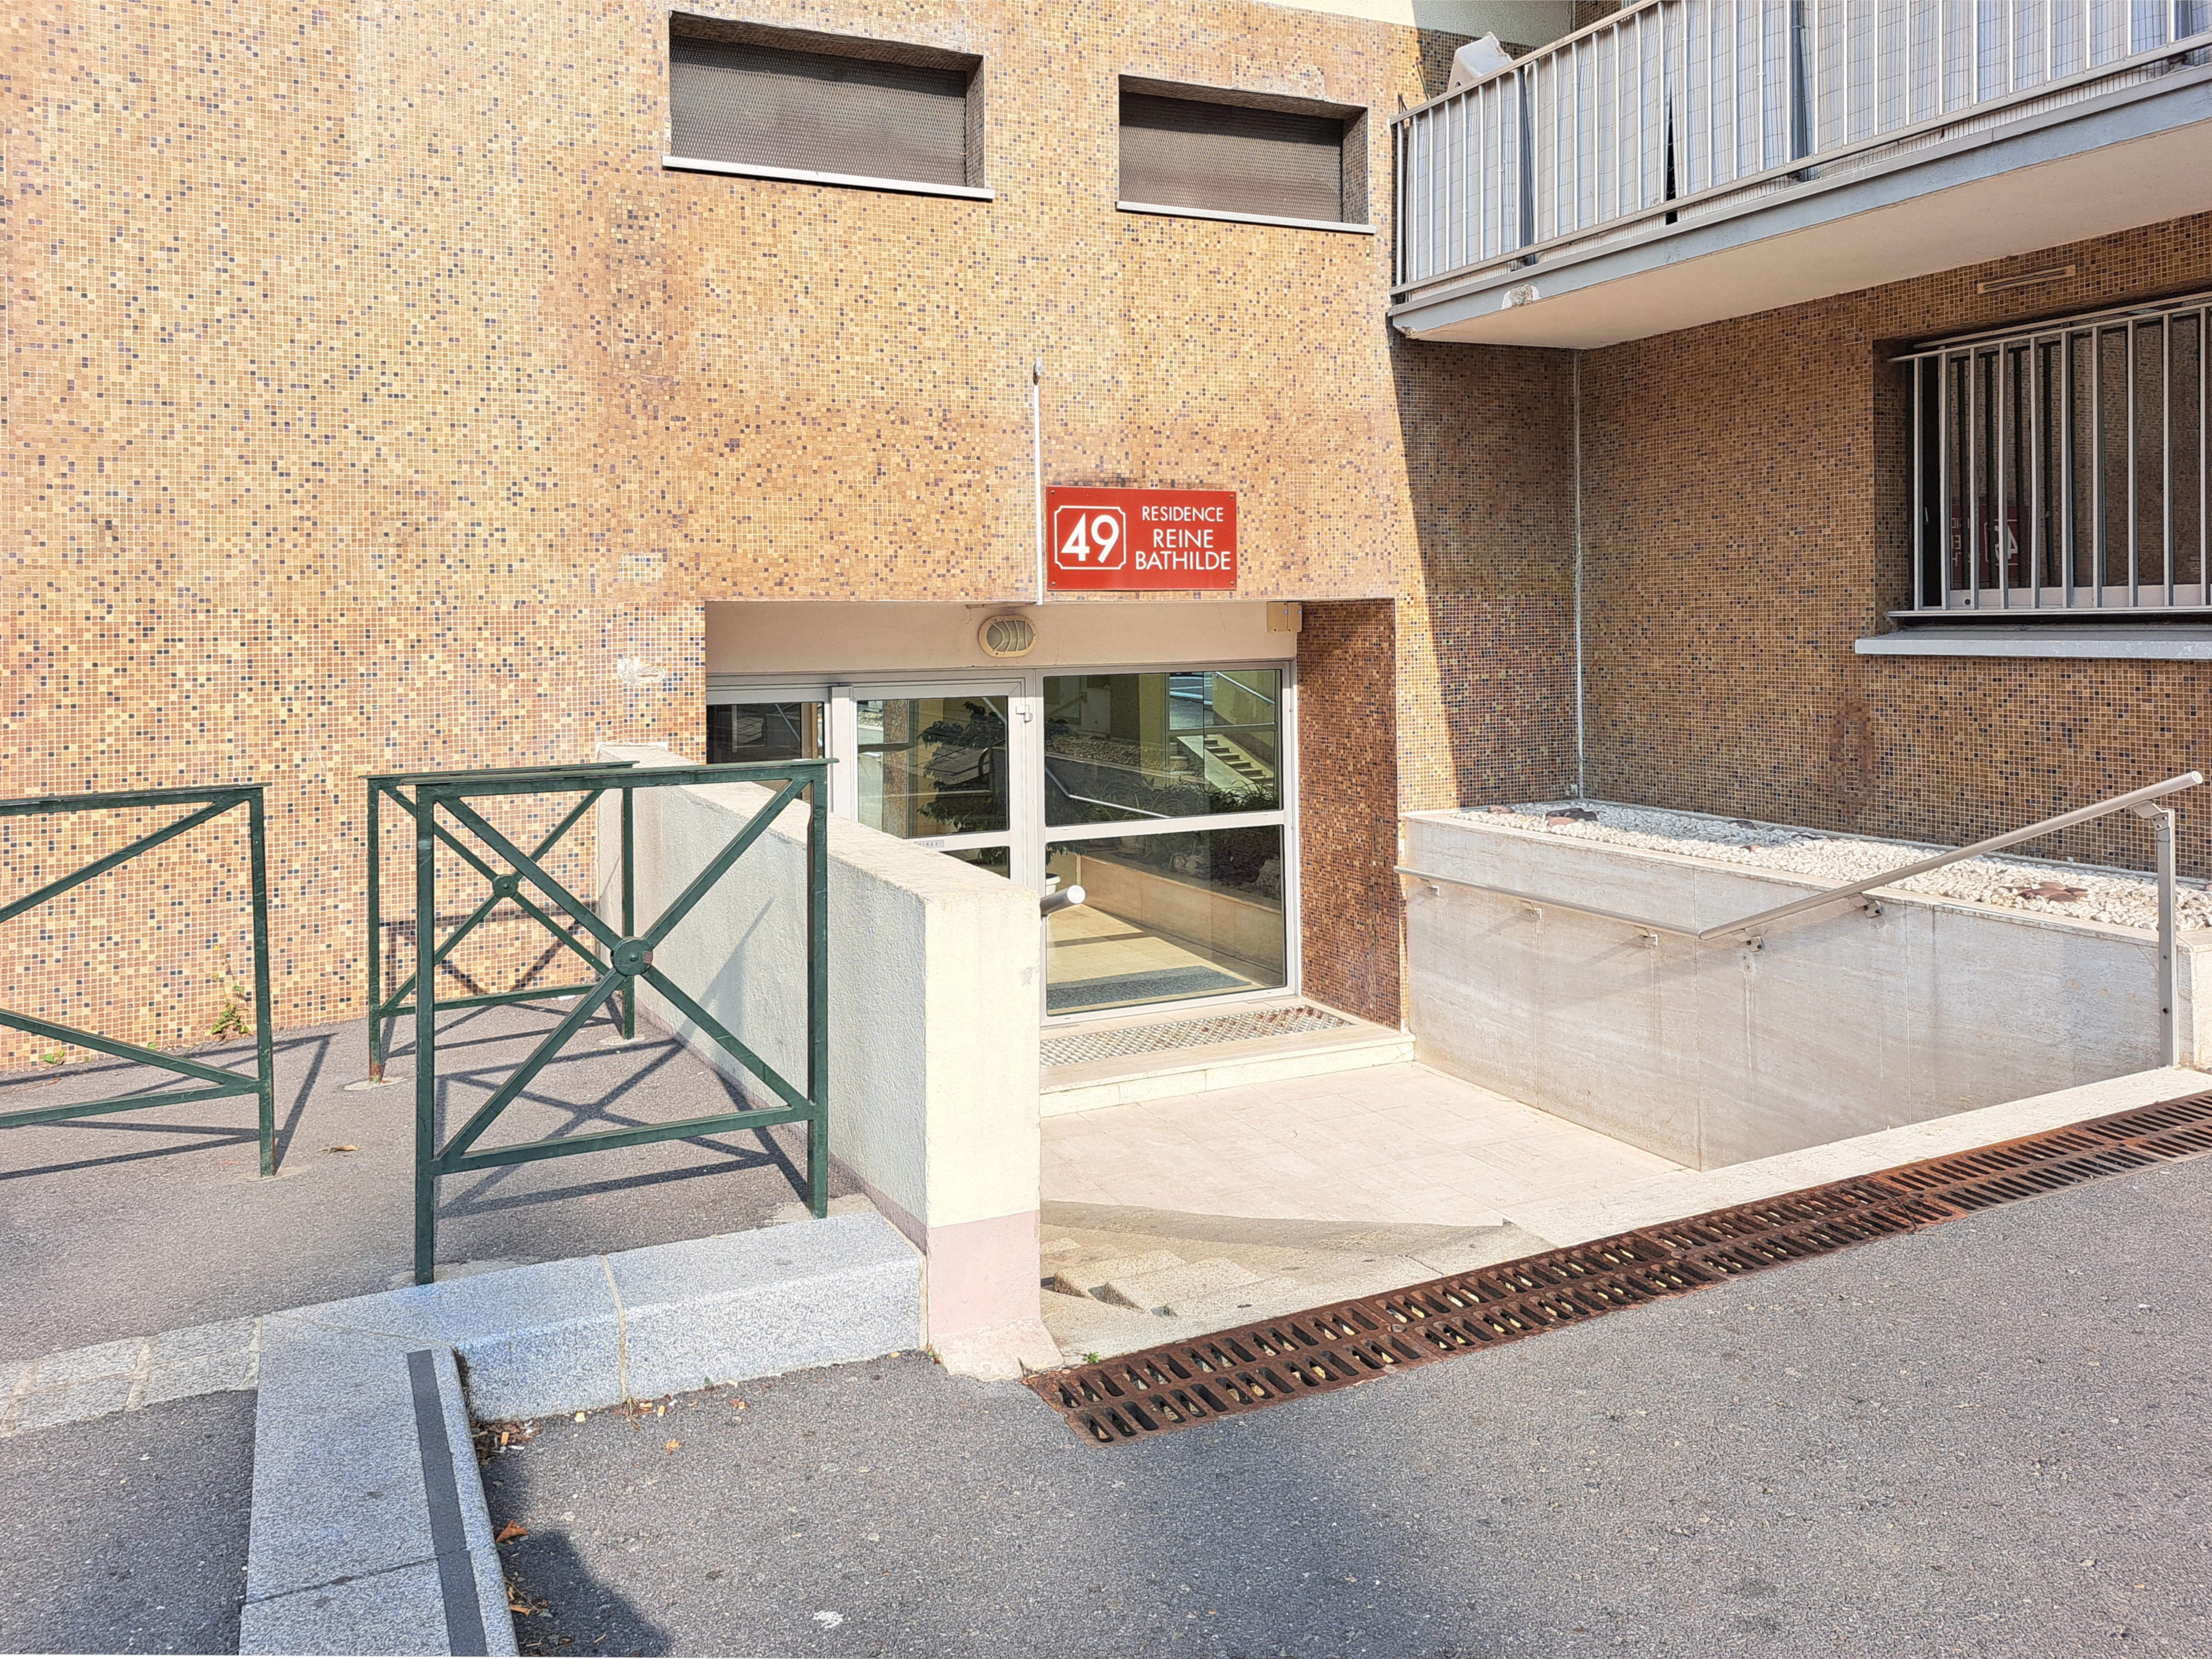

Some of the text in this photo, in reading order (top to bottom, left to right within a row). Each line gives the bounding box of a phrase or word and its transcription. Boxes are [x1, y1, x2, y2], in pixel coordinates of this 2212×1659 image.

[1142, 506, 1223, 522] RESIDENCE
[1061, 512, 1120, 564] 49
[1153, 529, 1213, 548] REINE
[1136, 551, 1231, 570] BATHILDE
